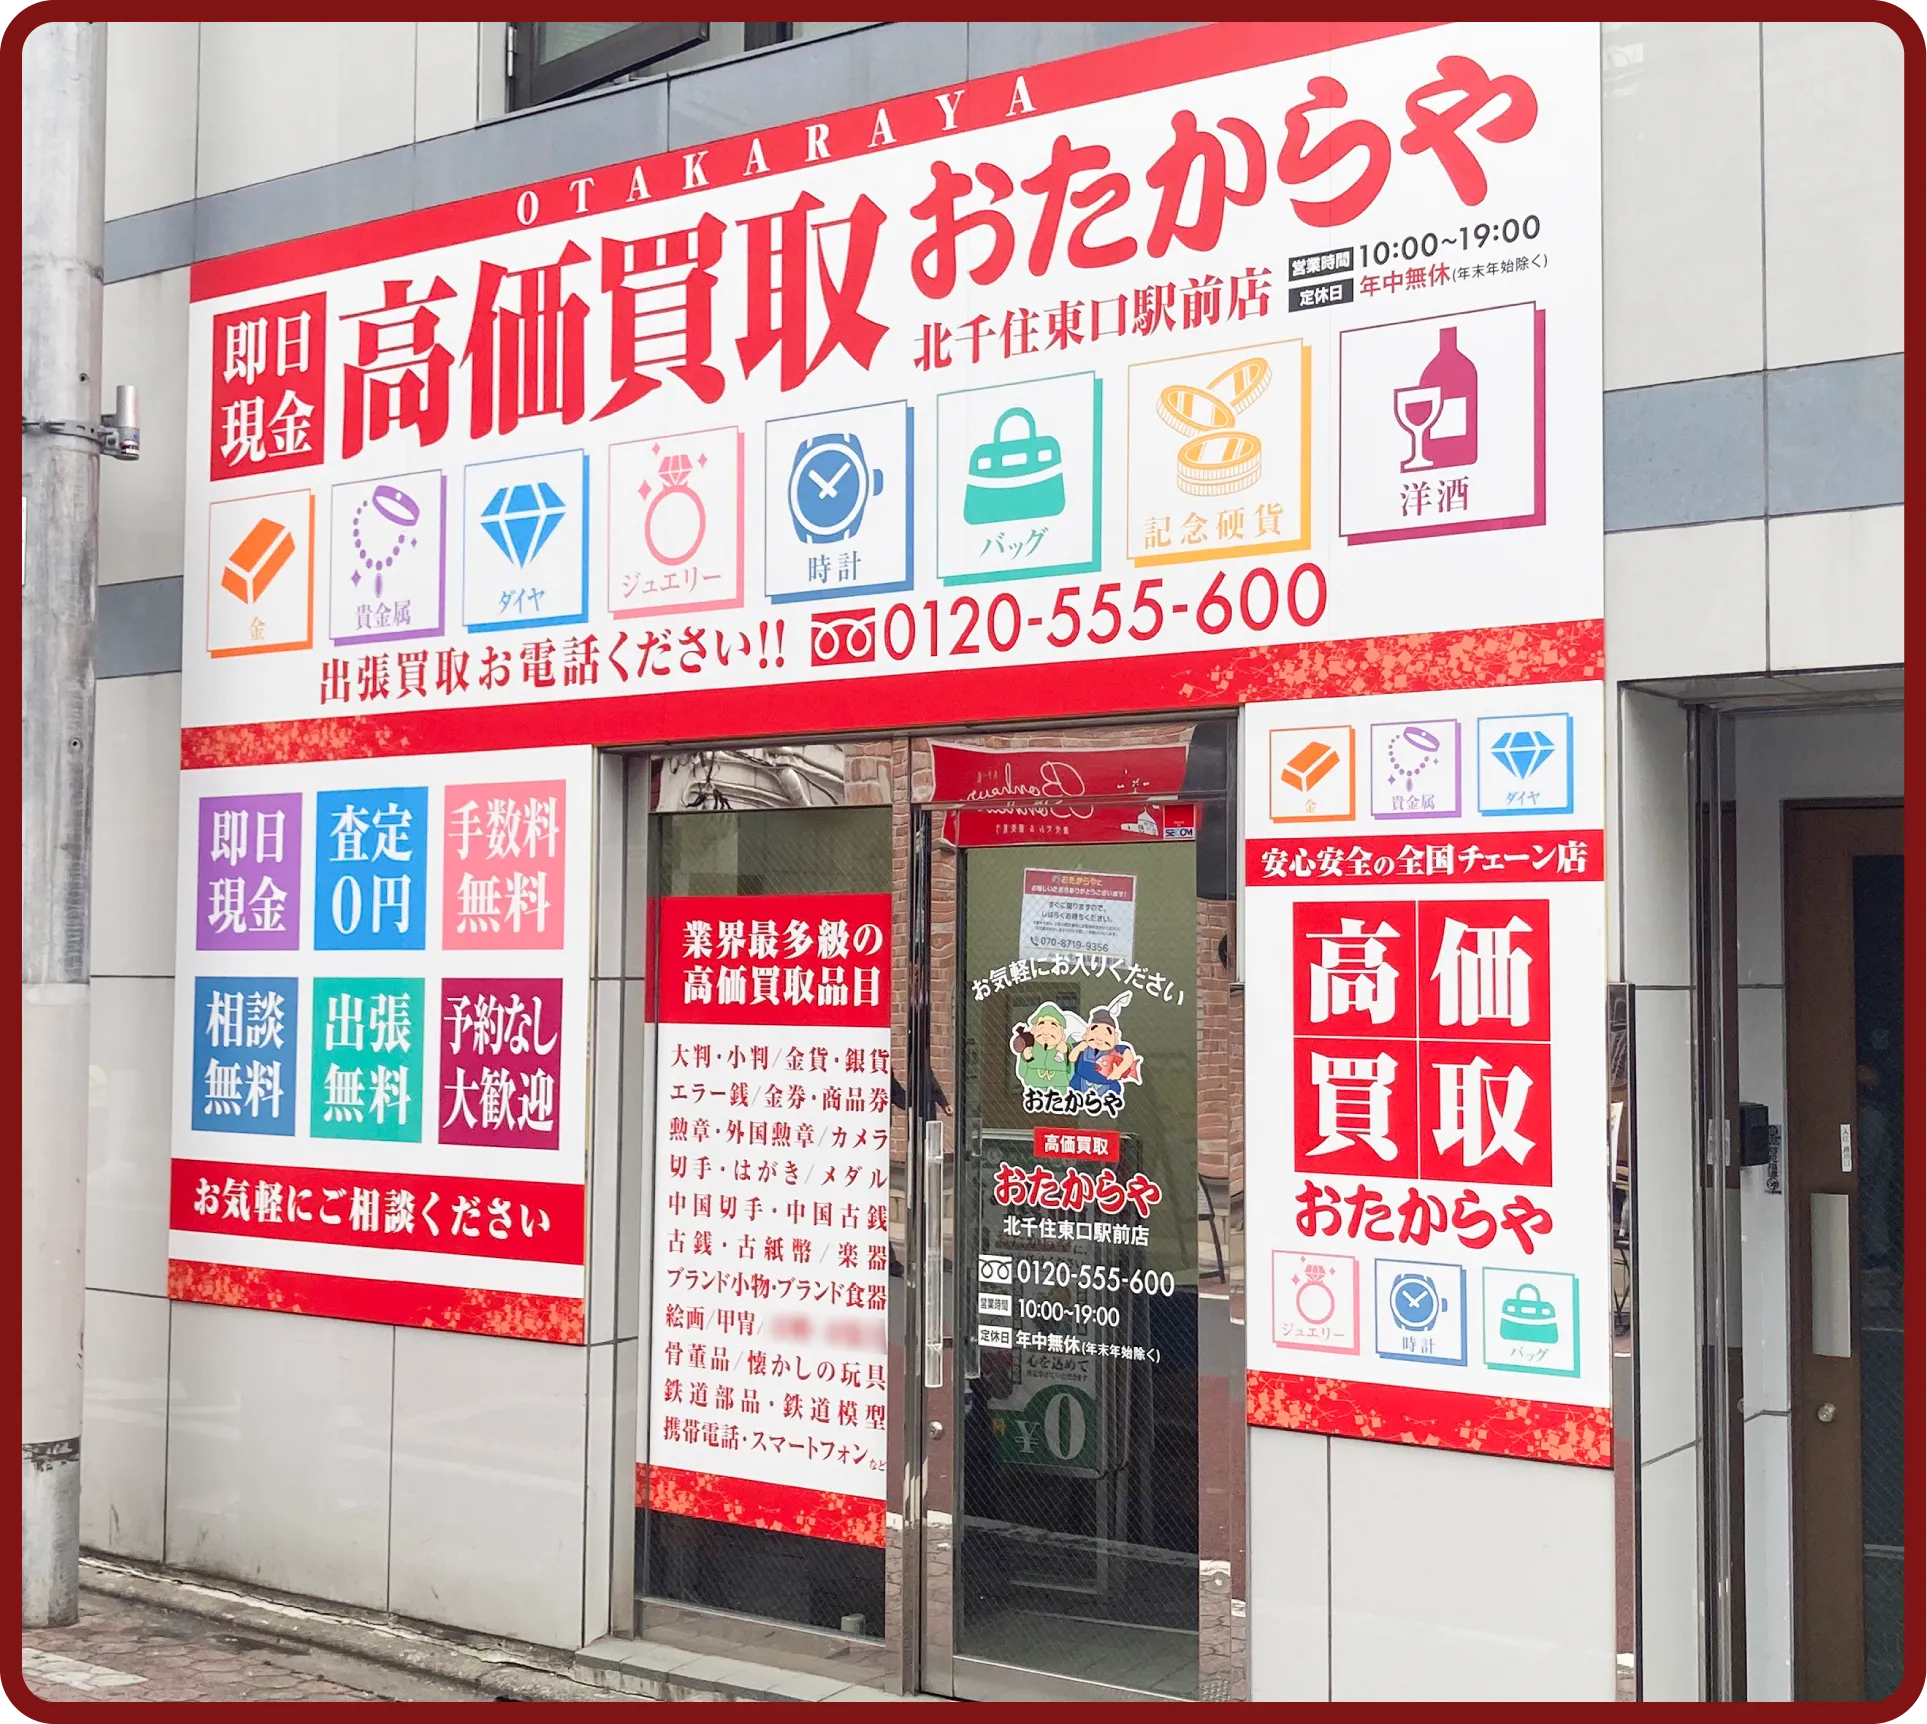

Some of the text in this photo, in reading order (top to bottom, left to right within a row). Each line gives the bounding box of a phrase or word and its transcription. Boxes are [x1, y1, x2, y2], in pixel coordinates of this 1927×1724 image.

[516, 76, 1038, 226] OTAKARAYA
[910, 55, 1539, 300] おたからや
[1291, 215, 1541, 277] 営業時間 10:00~19:00
[913, 268, 1272, 371] 北千住東口駅前店
[1300, 285, 1342, 307] 定休日
[222, 310, 313, 386] 即日
[338, 190, 890, 460] 高価買取
[220, 389, 316, 467] 現金
[1399, 476, 1469, 517] 洋酒
[978, 528, 1047, 560] バッグ
[1144, 503, 1286, 550] 記念硬貨
[621, 566, 722, 599] ジュエリー
[807, 550, 862, 583] 時計
[355, 600, 412, 630] 貴金属
[498, 590, 545, 615] ダイヤ
[246, 615, 266, 641] 金
[320, 563, 1327, 705] 出張買取お電話ください!! 0120-555-600
[1304, 799, 1318, 813] 金
[1391, 794, 1435, 811] 貴金属
[1505, 791, 1541, 806] ダイヤ
[210, 809, 285, 866] 即日
[329, 802, 414, 863] 査定
[448, 797, 560, 861] 手数料
[1165, 828, 1193, 837] SECOM
[1261, 840, 1588, 879] 安心安全の全国チェーン店
[208, 876, 288, 933] 現金
[332, 874, 412, 935] 0円
[456, 871, 551, 933] 無料
[682, 919, 884, 959] 業界最多級の
[1040, 936, 1109, 953] 070-8719-9356
[683, 965, 880, 1007] 高価買取品目
[971, 953, 1185, 1006] お気軽にお入りください
[1305, 915, 1534, 1027] 高価
[206, 990, 285, 1048] 相談
[325, 992, 412, 1053] 出張
[443, 993, 558, 1056] 予約なし
[203, 1058, 284, 1118] 無料
[323, 1063, 410, 1125] 無料
[442, 1067, 554, 1132] 大歓迎
[1023, 1088, 1125, 1118] おたからや
[1305, 1051, 1536, 1167] 買取
[1044, 1134, 1109, 1155] 高価買取
[193, 1176, 551, 1240] お気軽にご相談ください
[993, 1161, 1162, 1218] おたからや
[1003, 1215, 1149, 1247] 北千住東口駅前店
[1295, 1179, 1553, 1255] おたからや
[1017, 1258, 1175, 1297] 0120-555-600
[980, 1329, 1010, 1344] 定休日
[1018, 1298, 1120, 1327] 10:00~19:00
[1282, 1322, 1346, 1340] ジュエリー
[1402, 1335, 1436, 1354] 時計
[1509, 1347, 1550, 1363] バッグ
